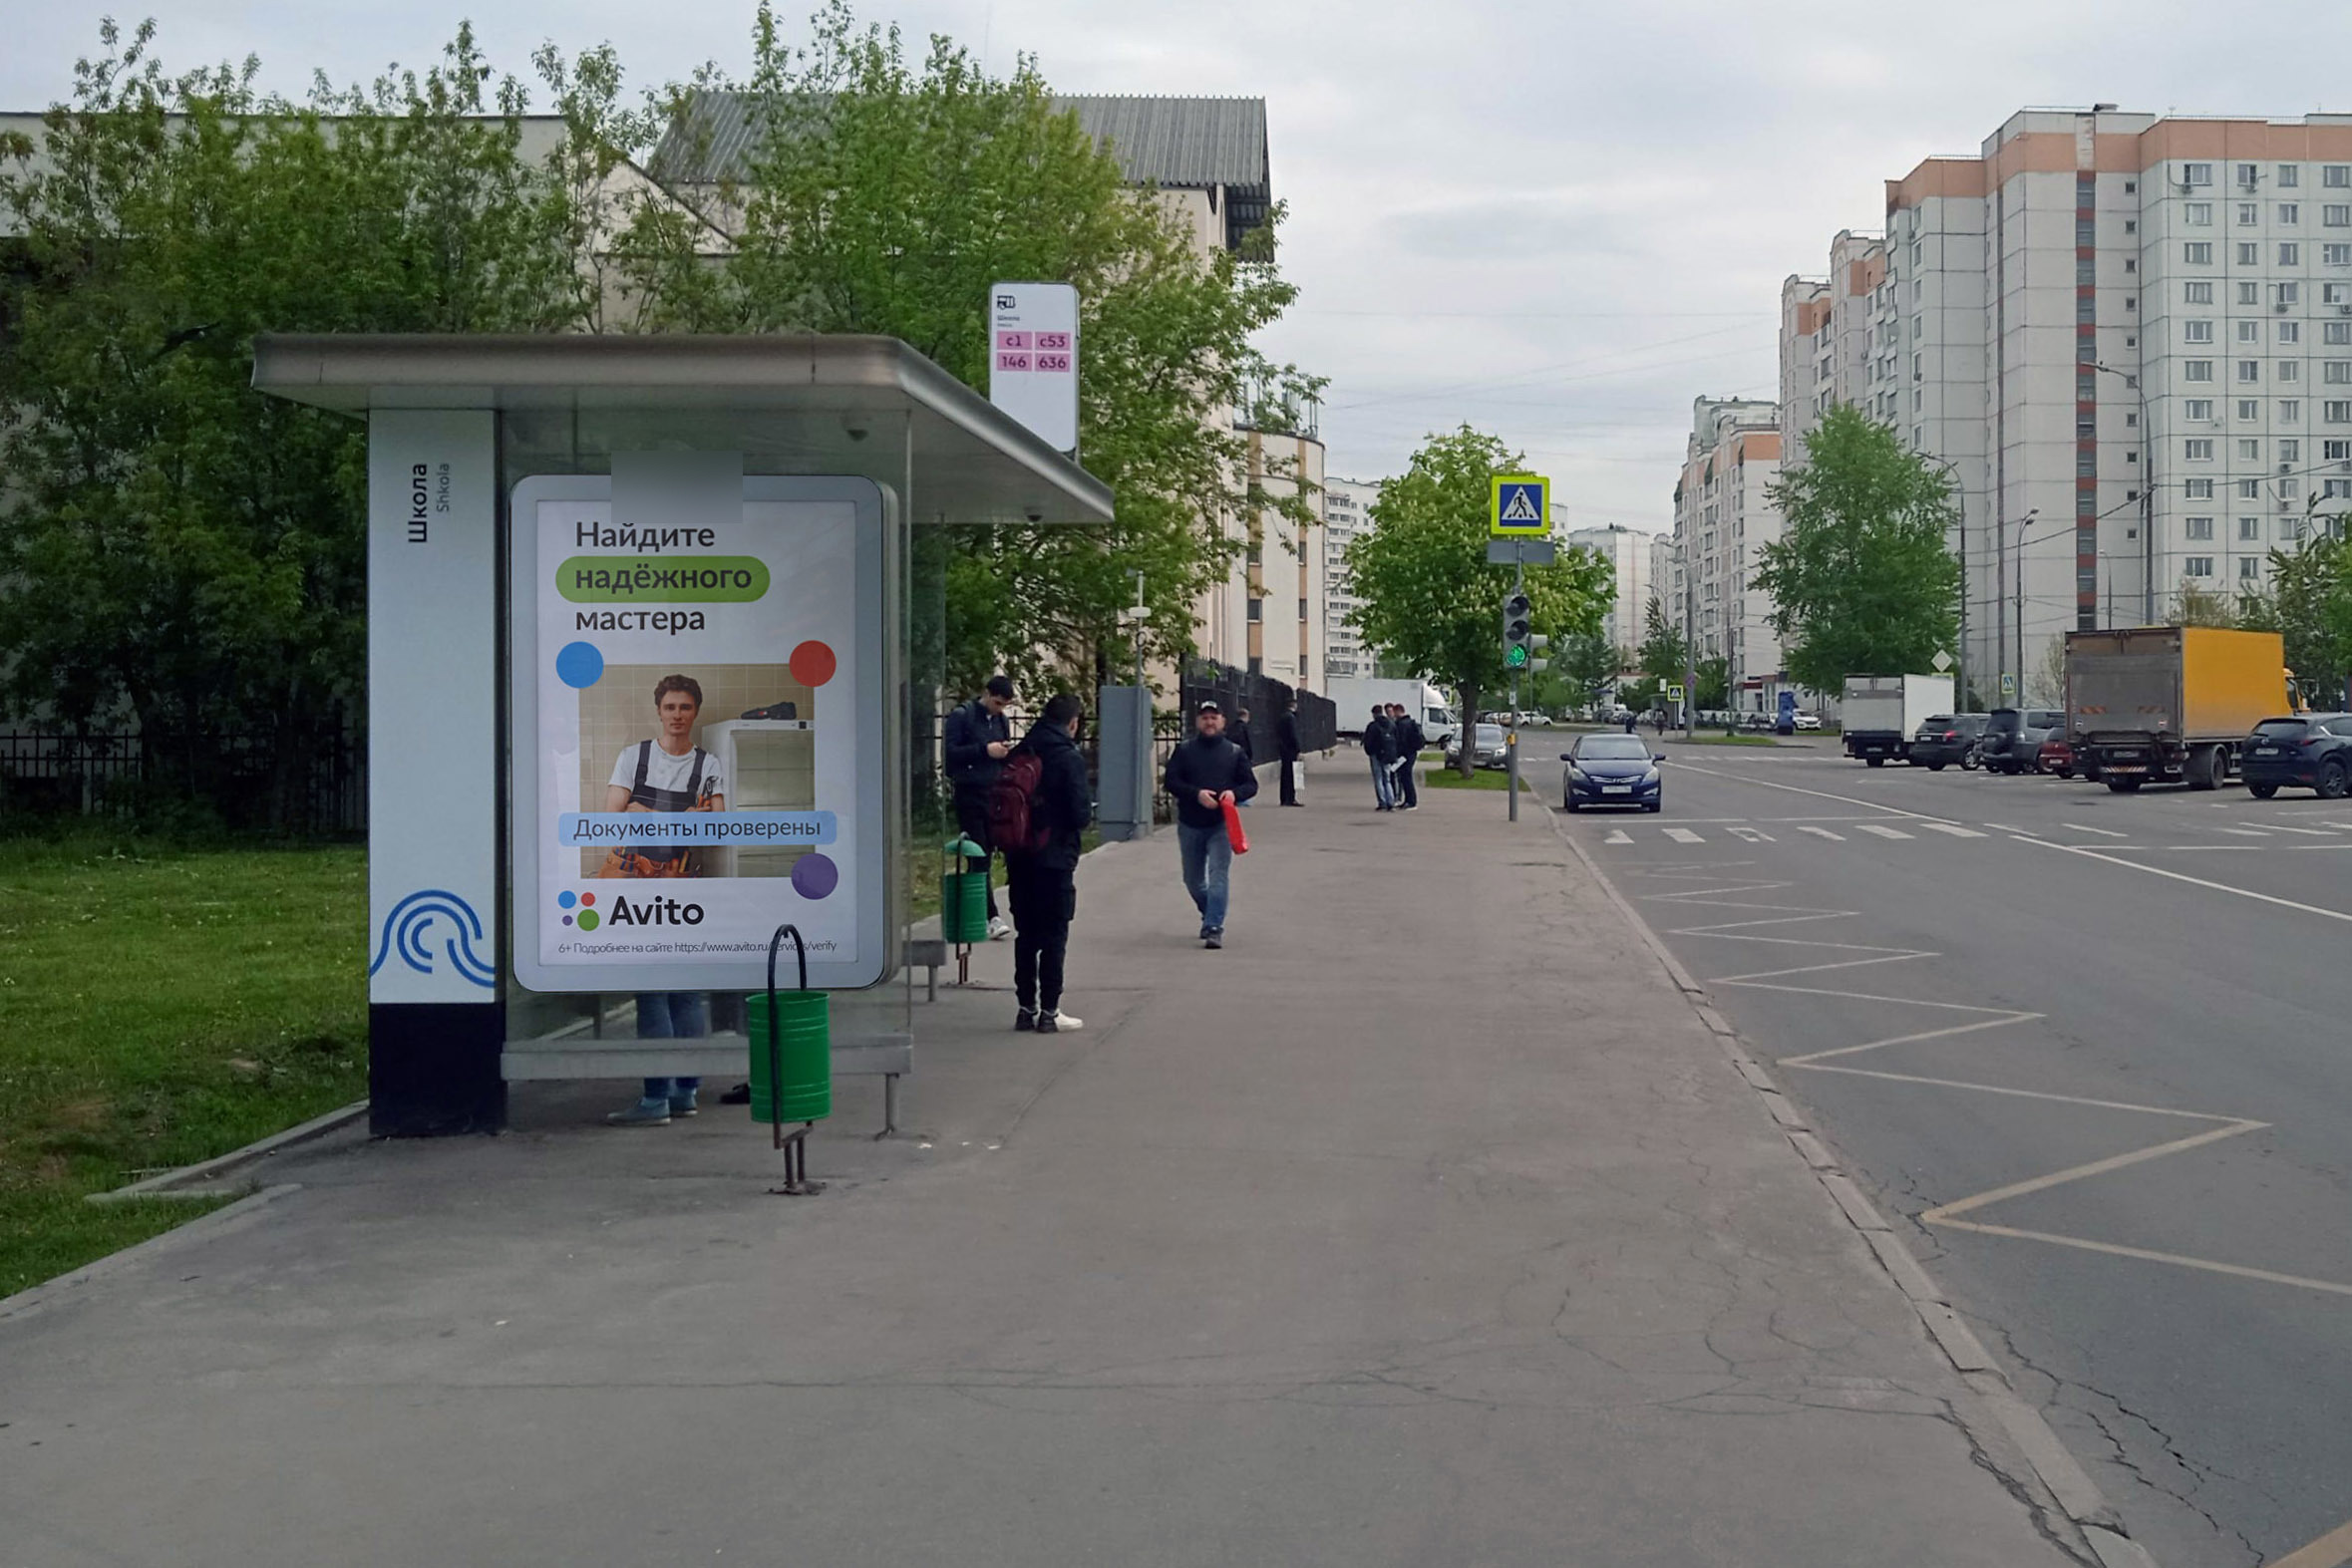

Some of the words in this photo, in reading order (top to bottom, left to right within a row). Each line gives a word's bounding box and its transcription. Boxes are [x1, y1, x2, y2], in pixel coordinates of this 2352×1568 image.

[1003, 356, 1026, 368] 146
[1039, 356, 1066, 369] 636
[436, 463, 450, 512] Shkola
[408, 464, 428, 542] Школа
[576, 521, 715, 552] Найдите
[575, 563, 752, 594] надёжного
[575, 610, 705, 635] мастера
[573, 818, 698, 840] Документы
[704, 820, 821, 841] проверены
[608, 895, 704, 925] Avito
[558, 942, 571, 954] 6+
[573, 942, 630, 954] Подробнее
[645, 943, 673, 953] сайте
